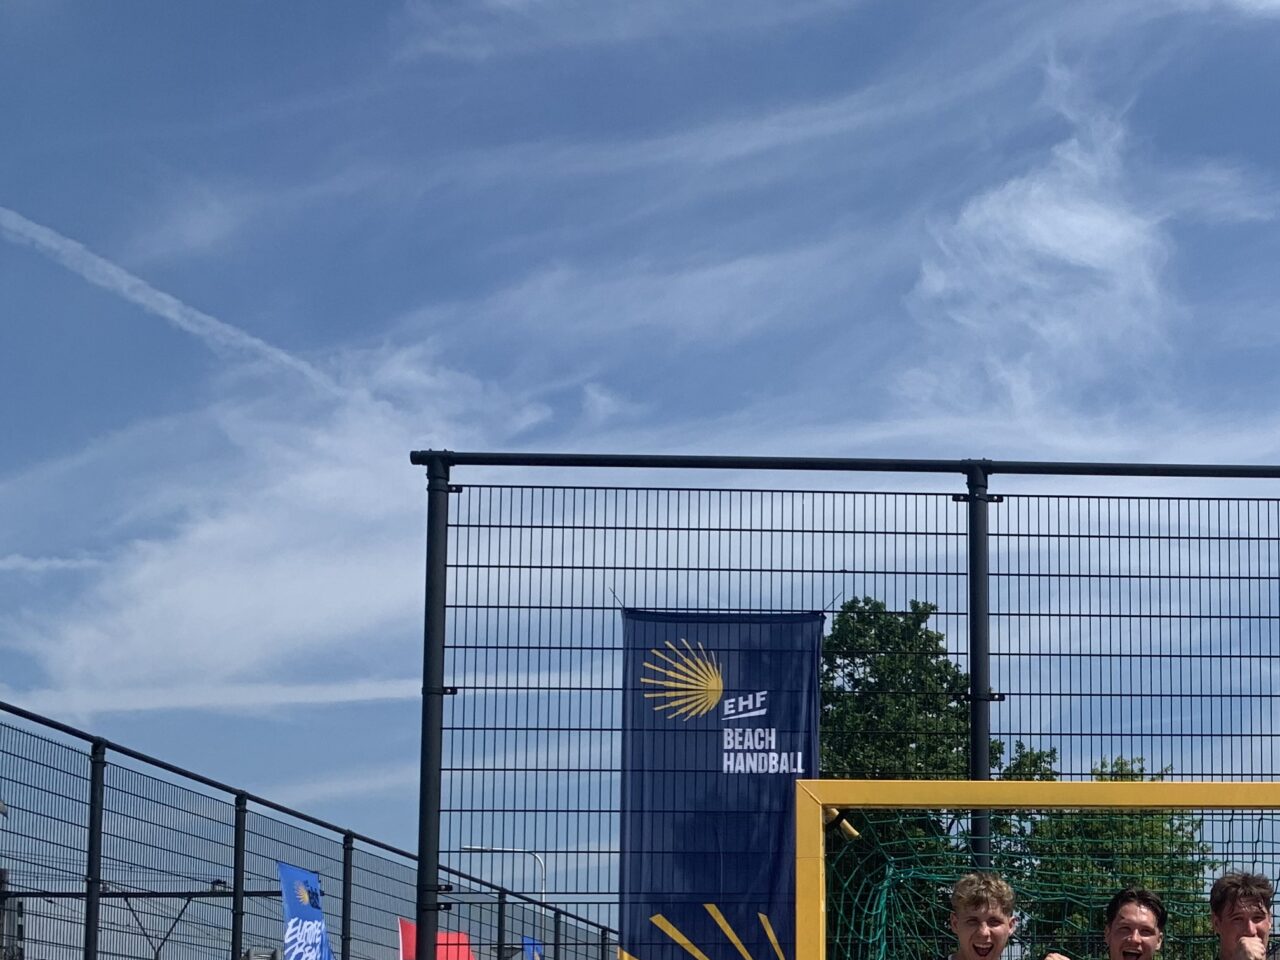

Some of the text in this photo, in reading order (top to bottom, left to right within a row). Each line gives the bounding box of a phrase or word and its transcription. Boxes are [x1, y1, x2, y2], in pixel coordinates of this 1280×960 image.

[724, 690, 768, 715] EHF
[723, 728, 776, 750] BEACH
[723, 752, 806, 774] HANDBALL
